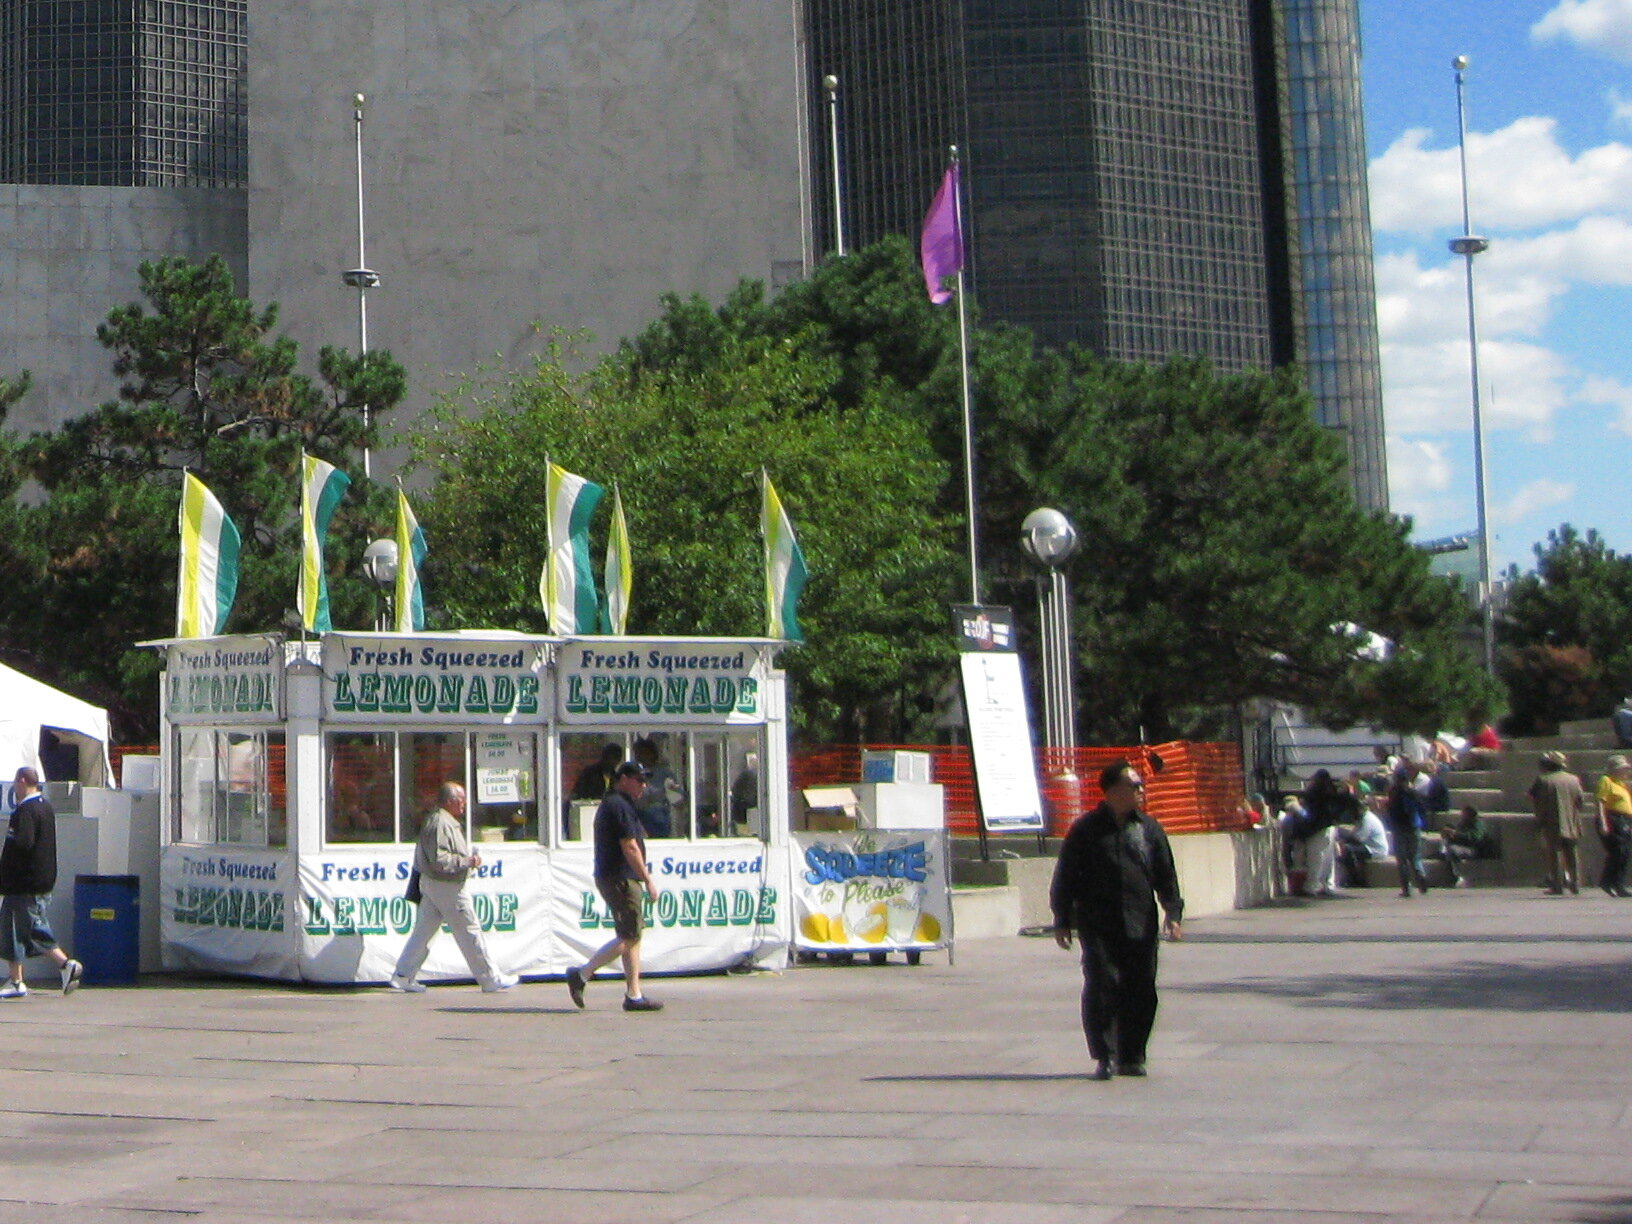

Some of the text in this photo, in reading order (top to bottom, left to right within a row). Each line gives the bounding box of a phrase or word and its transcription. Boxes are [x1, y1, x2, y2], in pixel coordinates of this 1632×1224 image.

[214, 648, 270, 671] Squeezed
[350, 647, 524, 670] Fresh Squeezed
[581, 650, 744, 672] Fresh Squeezed
[333, 671, 539, 713] LEMONADE
[566, 674, 758, 714] LEMONADE
[183, 857, 276, 881] Fresh Squeezed
[321, 863, 386, 881] Fresh
[661, 856, 762, 879] Squeezed
[805, 841, 927, 885] SQUEEZE
[843, 880, 904, 909] Please
[174, 886, 285, 932] LEMONADE
